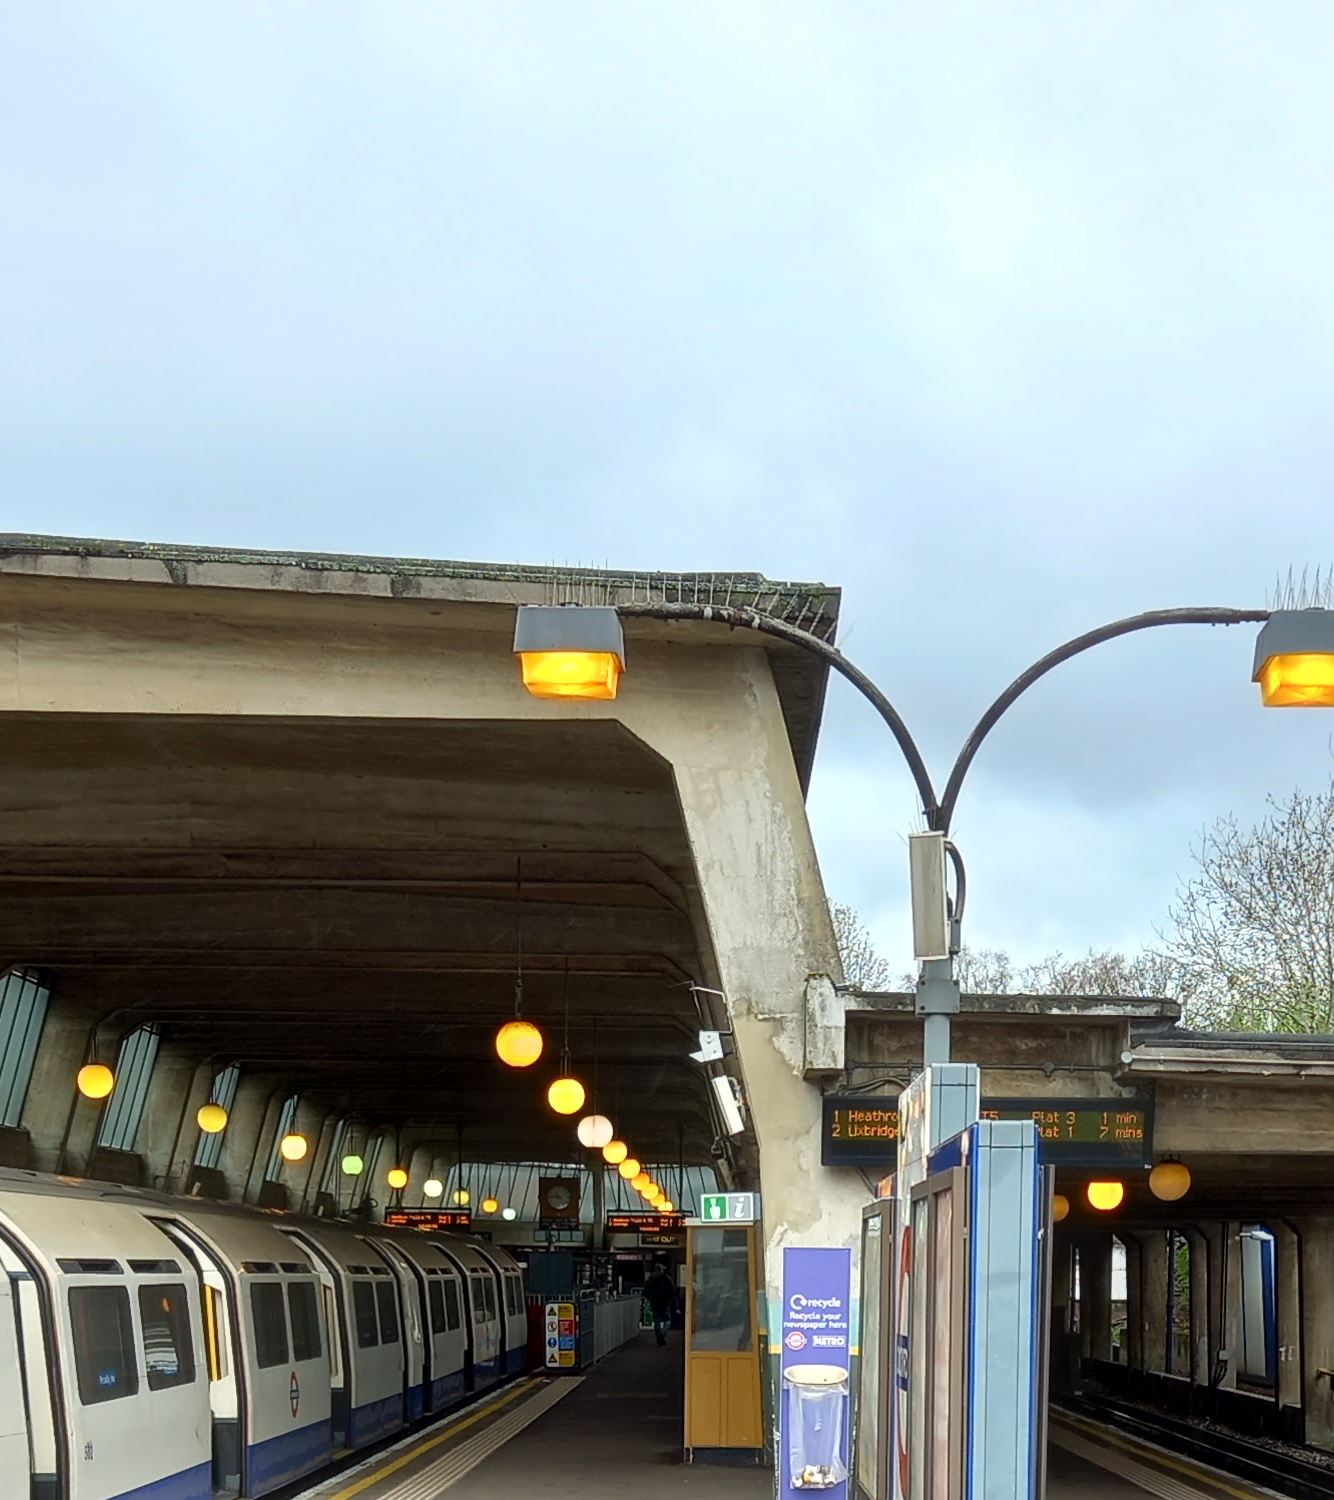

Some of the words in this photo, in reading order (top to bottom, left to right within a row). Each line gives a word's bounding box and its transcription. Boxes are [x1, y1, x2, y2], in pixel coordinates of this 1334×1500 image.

[834, 1110, 839, 1122] 1
[1032, 1111, 1059, 1123] Plat
[1066, 1111, 1076, 1124] 3
[1102, 1111, 1108, 1123] 1
[1116, 1112, 1136, 1123] min
[832, 1124, 841, 1137] 2
[1068, 1127, 1073, 1138] 1
[1099, 1127, 1108, 1139] 7
[1115, 1127, 1144, 1138] mins
[807, 1297, 841, 1309] recycle
[790, 1311, 821, 1321] Recycle
[822, 1313, 842, 1321] your
[783, 1321, 827, 1330] newspaper
